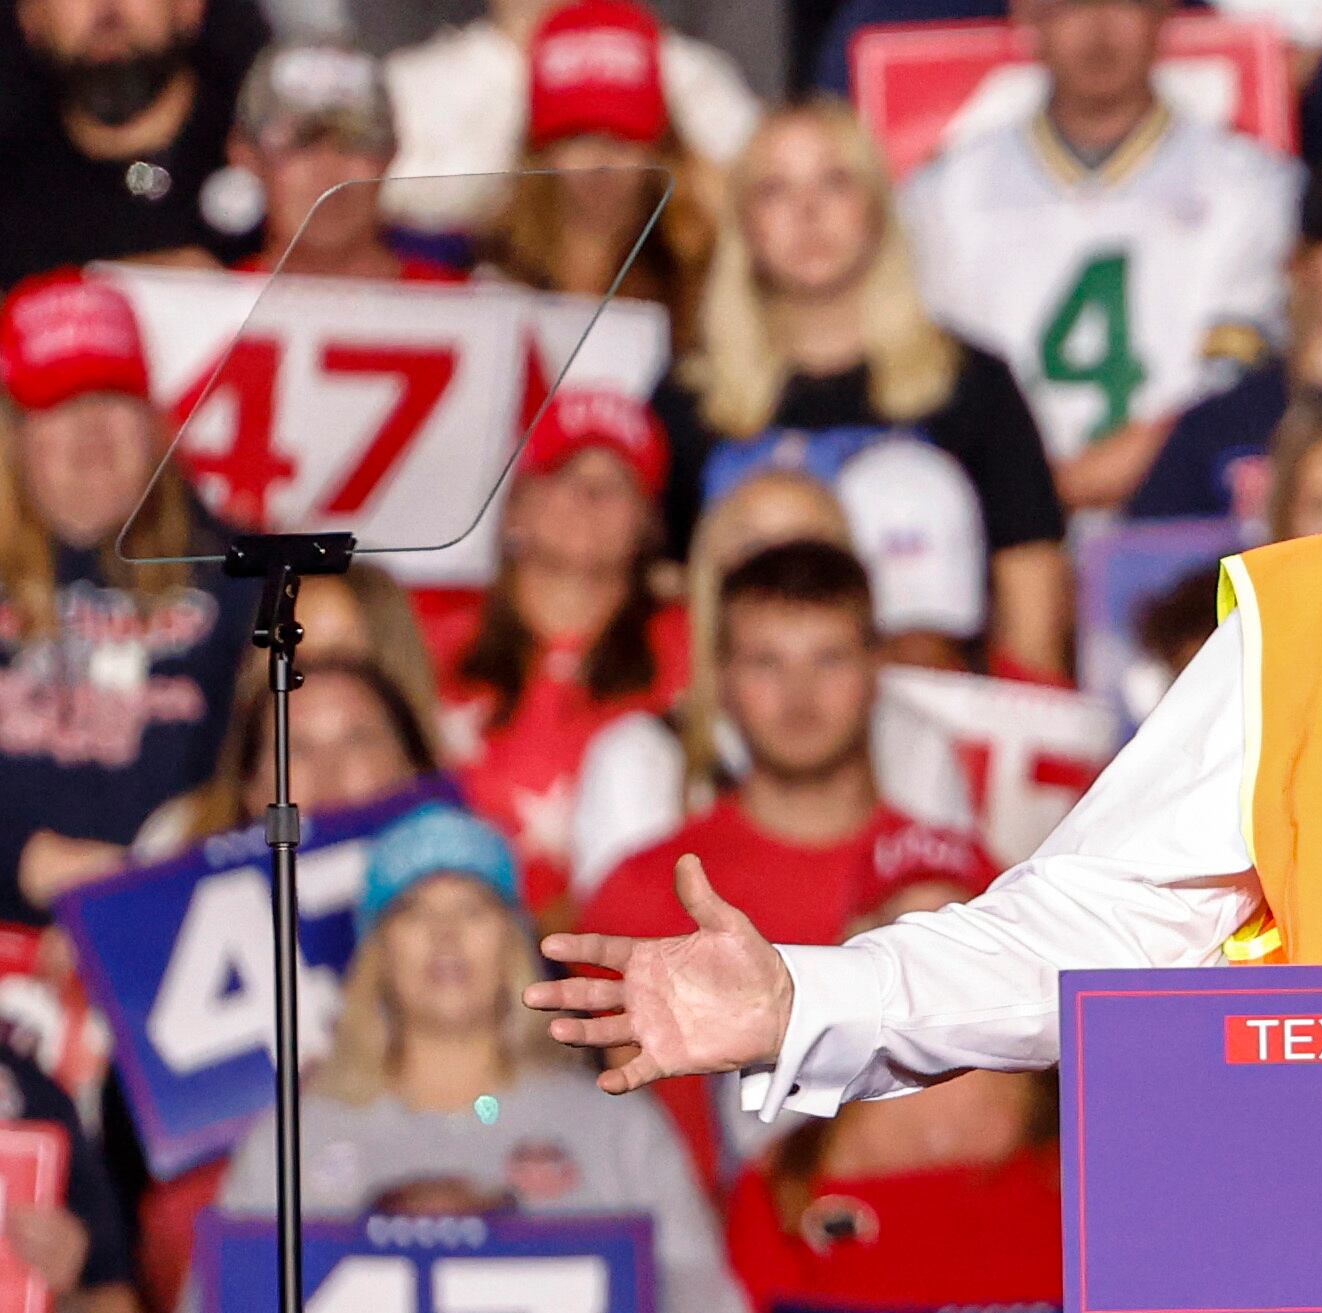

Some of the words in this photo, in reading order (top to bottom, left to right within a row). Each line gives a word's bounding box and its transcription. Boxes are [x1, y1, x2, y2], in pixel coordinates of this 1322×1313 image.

[165, 332, 460, 538] 47
[1038, 248, 1147, 448] 4
[148, 840, 372, 1082] 4
